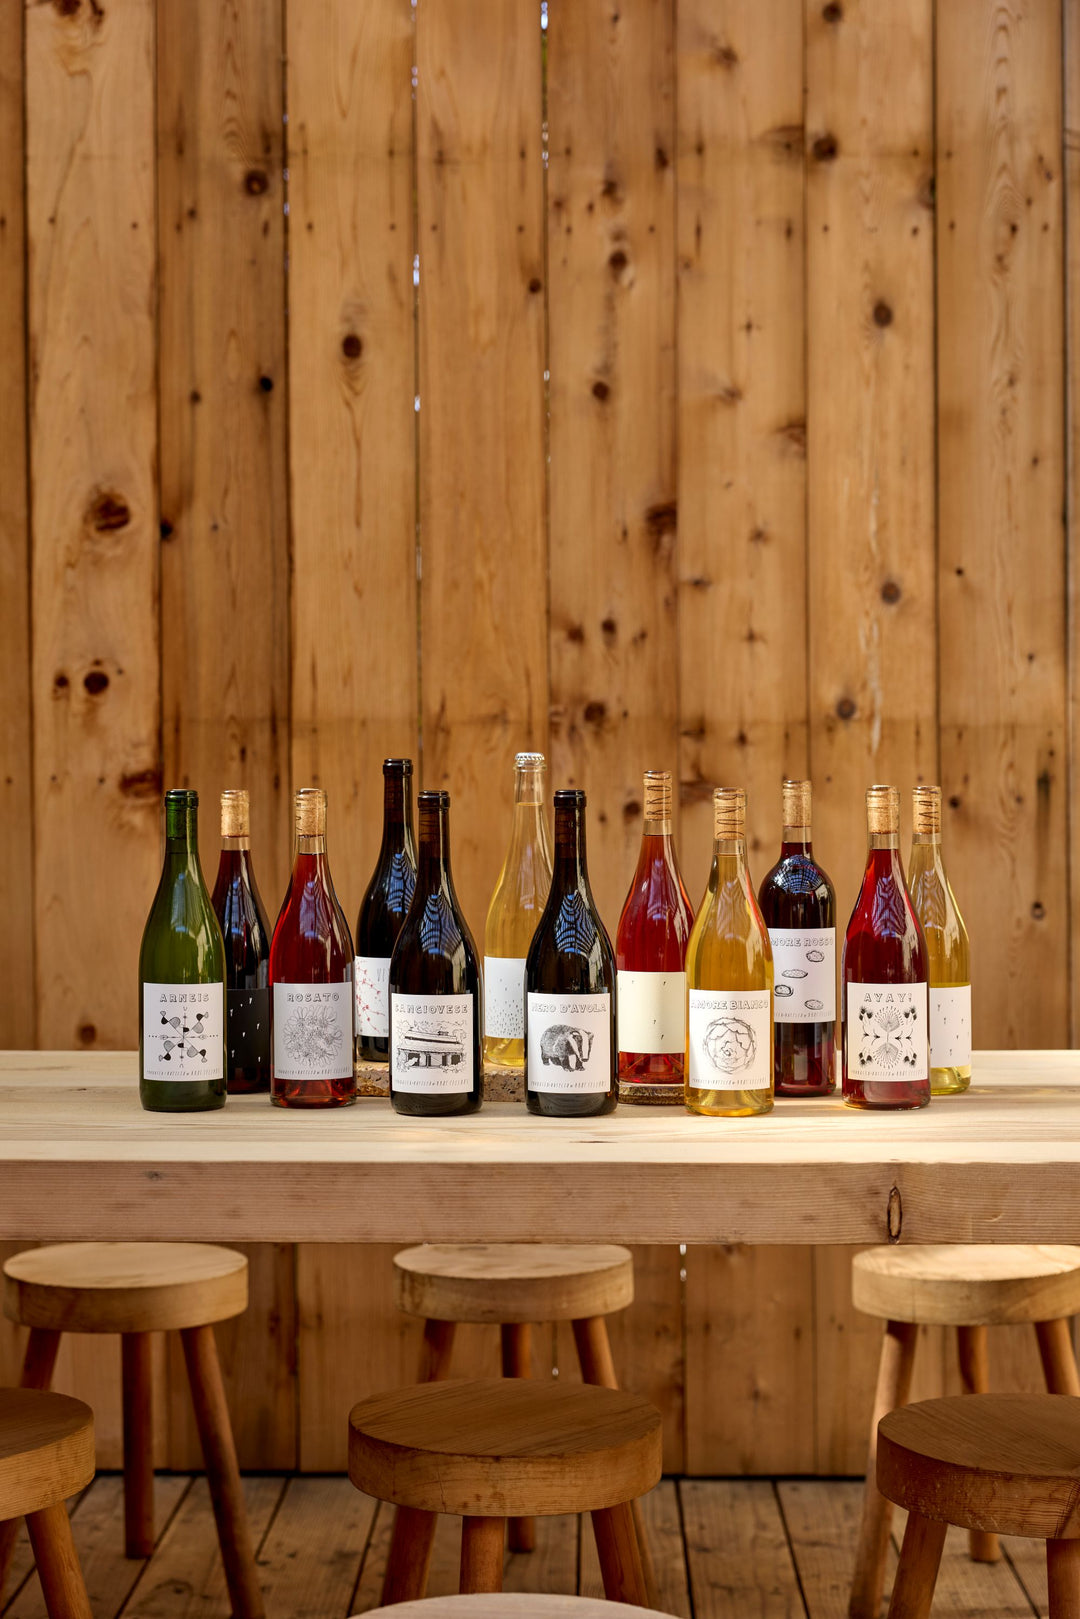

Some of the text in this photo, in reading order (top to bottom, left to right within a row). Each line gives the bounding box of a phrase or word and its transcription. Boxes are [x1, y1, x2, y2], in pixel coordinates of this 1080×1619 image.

[771, 937, 802, 947] MORE
[159, 993, 210, 1003] ARNEIS
[287, 992, 340, 1003] ROSATO
[864, 992, 913, 1003] AYAY!
[560, 1003, 607, 1014] D'AVOLA
[691, 1000, 769, 1010] AMORE BIANCO
